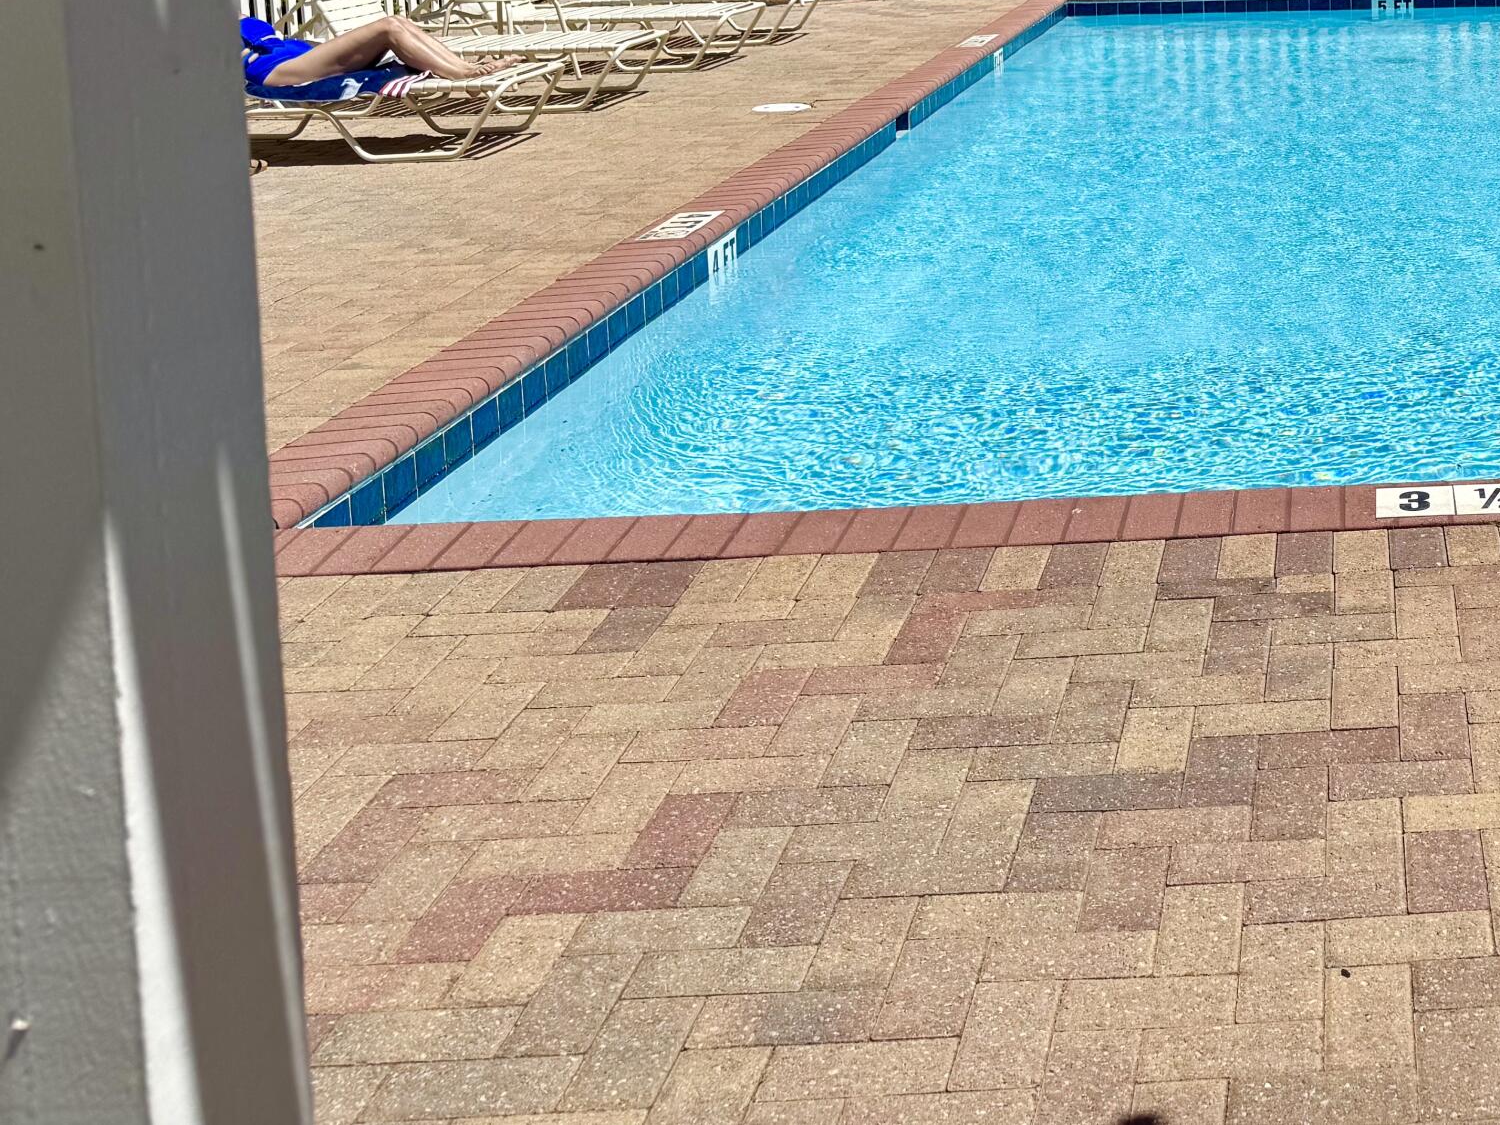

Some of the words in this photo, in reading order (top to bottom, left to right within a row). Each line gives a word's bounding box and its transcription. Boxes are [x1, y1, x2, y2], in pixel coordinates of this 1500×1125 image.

[1378, 0, 1387, 11] 5
[1394, 0, 1412, 10] FT
[713, 250, 720, 273] 4
[723, 237, 735, 266] FT
[1398, 490, 1431, 511] 3
